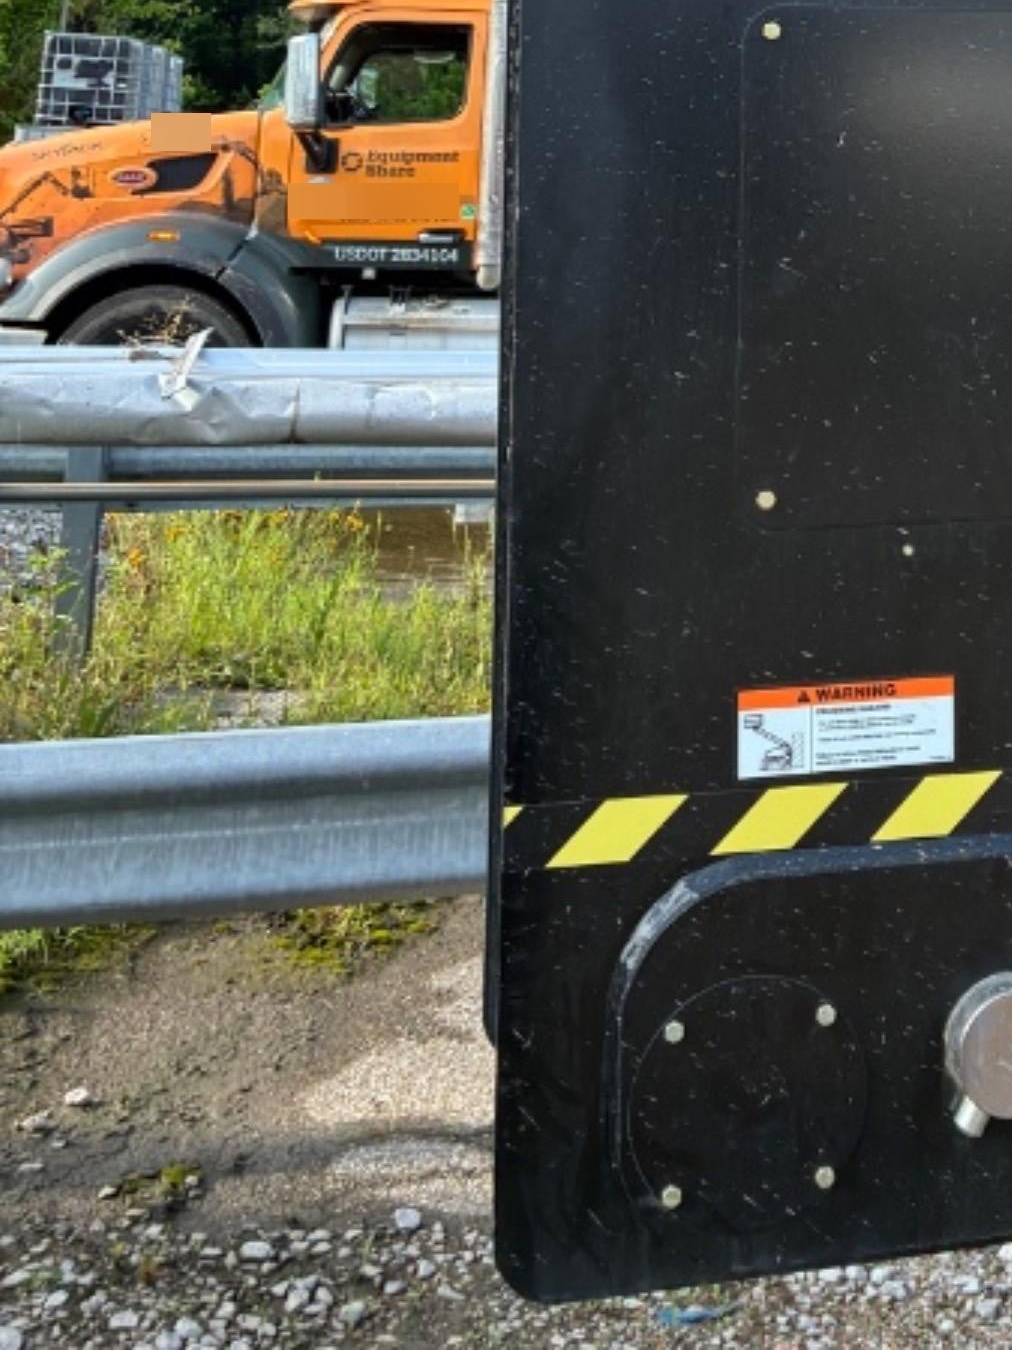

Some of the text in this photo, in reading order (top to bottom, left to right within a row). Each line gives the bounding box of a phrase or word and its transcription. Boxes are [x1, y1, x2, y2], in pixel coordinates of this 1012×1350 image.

[367, 151, 460, 166] Equipment
[365, 165, 416, 179] Share
[334, 246, 387, 262] USDOT
[815, 683, 898, 703] WARNING
